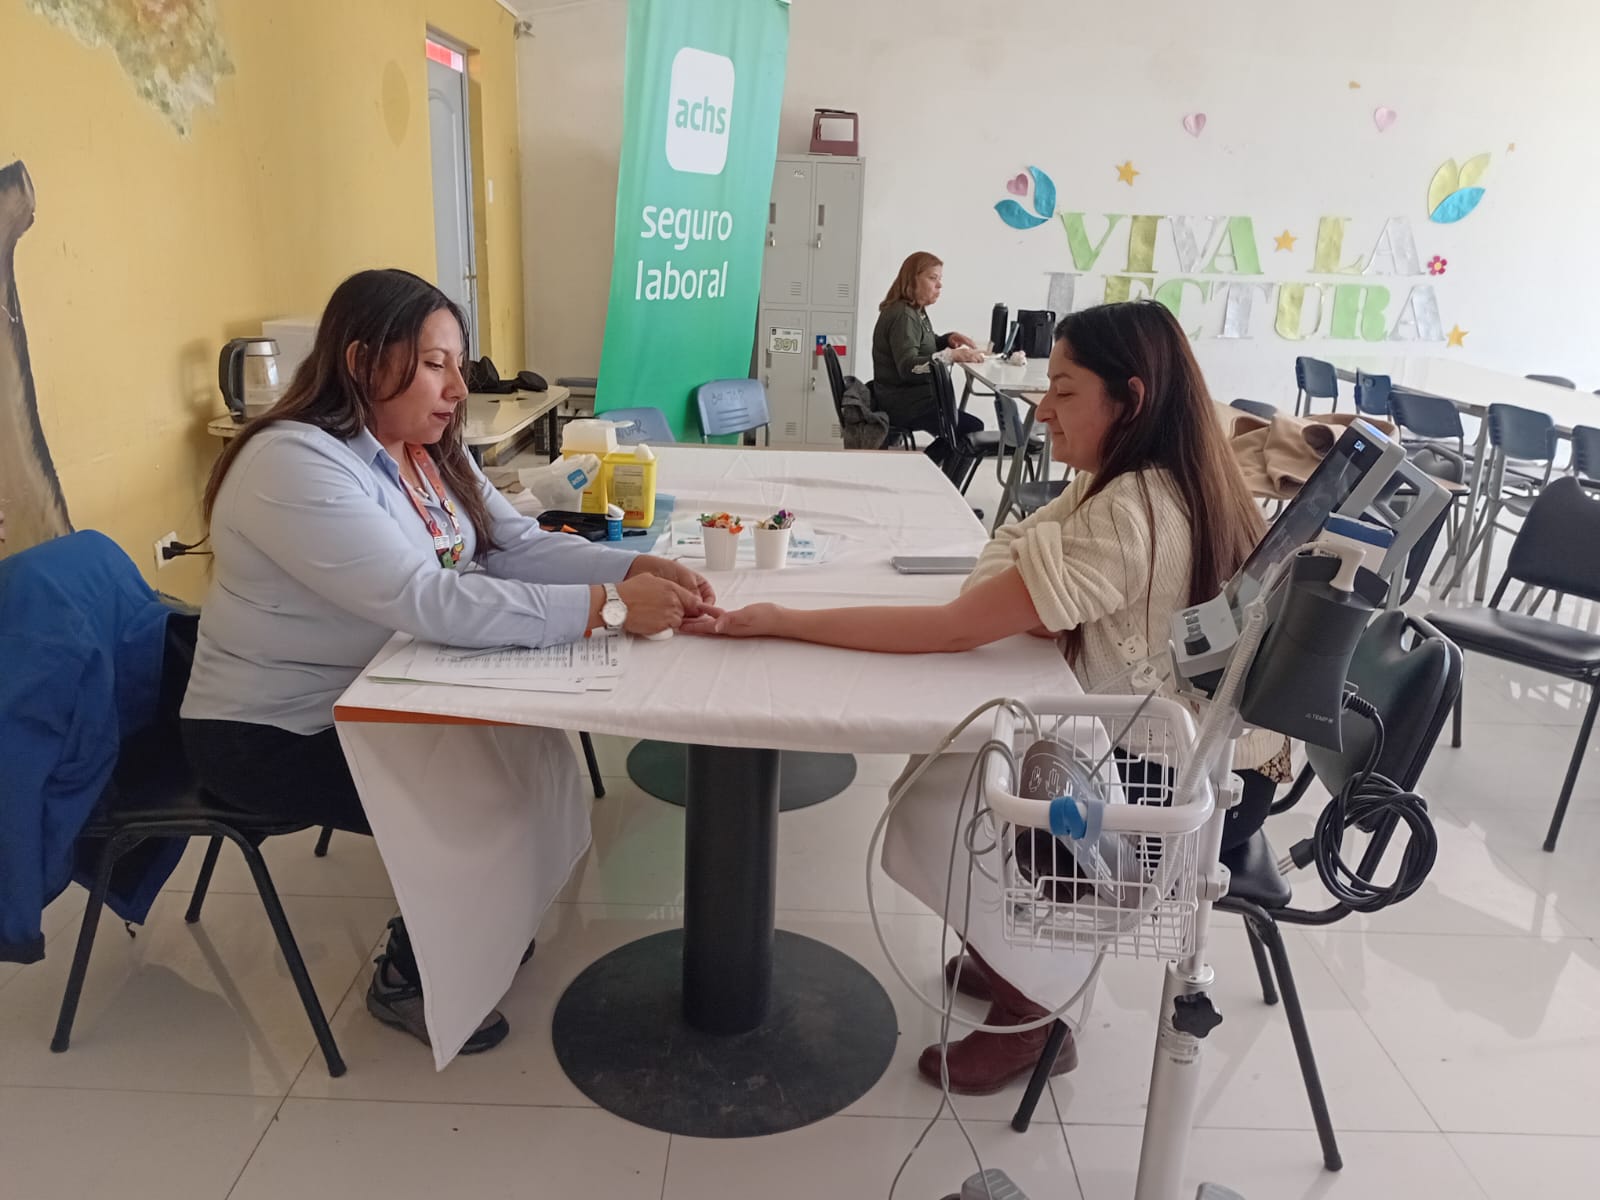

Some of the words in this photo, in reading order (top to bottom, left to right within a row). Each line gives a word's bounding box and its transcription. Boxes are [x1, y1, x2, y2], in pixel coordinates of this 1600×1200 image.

[675, 96, 727, 135] achs
[640, 205, 733, 251] seguro
[1060, 212, 1264, 275] VIVA
[1306, 216, 1427, 276] LA
[635, 260, 729, 300] laboral
